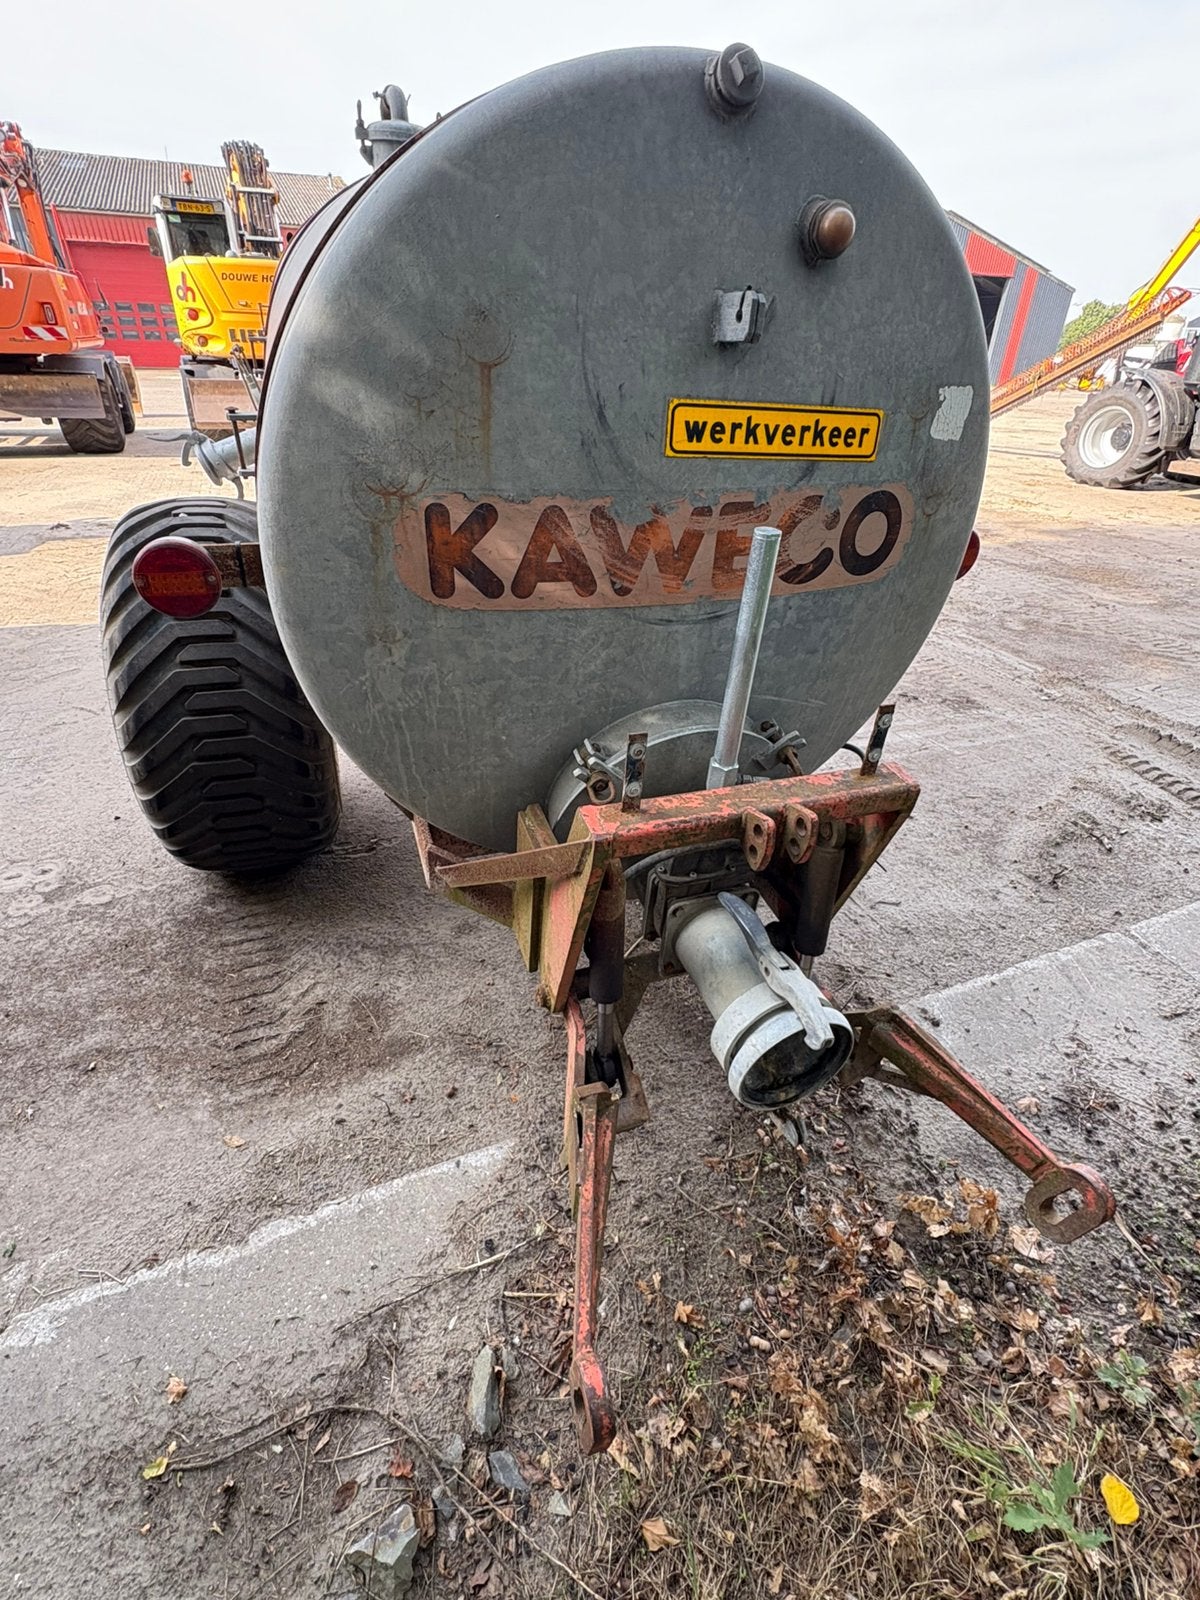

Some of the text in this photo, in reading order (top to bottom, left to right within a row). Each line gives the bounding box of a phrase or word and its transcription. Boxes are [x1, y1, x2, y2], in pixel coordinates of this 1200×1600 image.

[221, 272, 259, 282] DOUWE
[684, 415, 871, 448] werkverkeer
[423, 489, 903, 600] KAWECO
